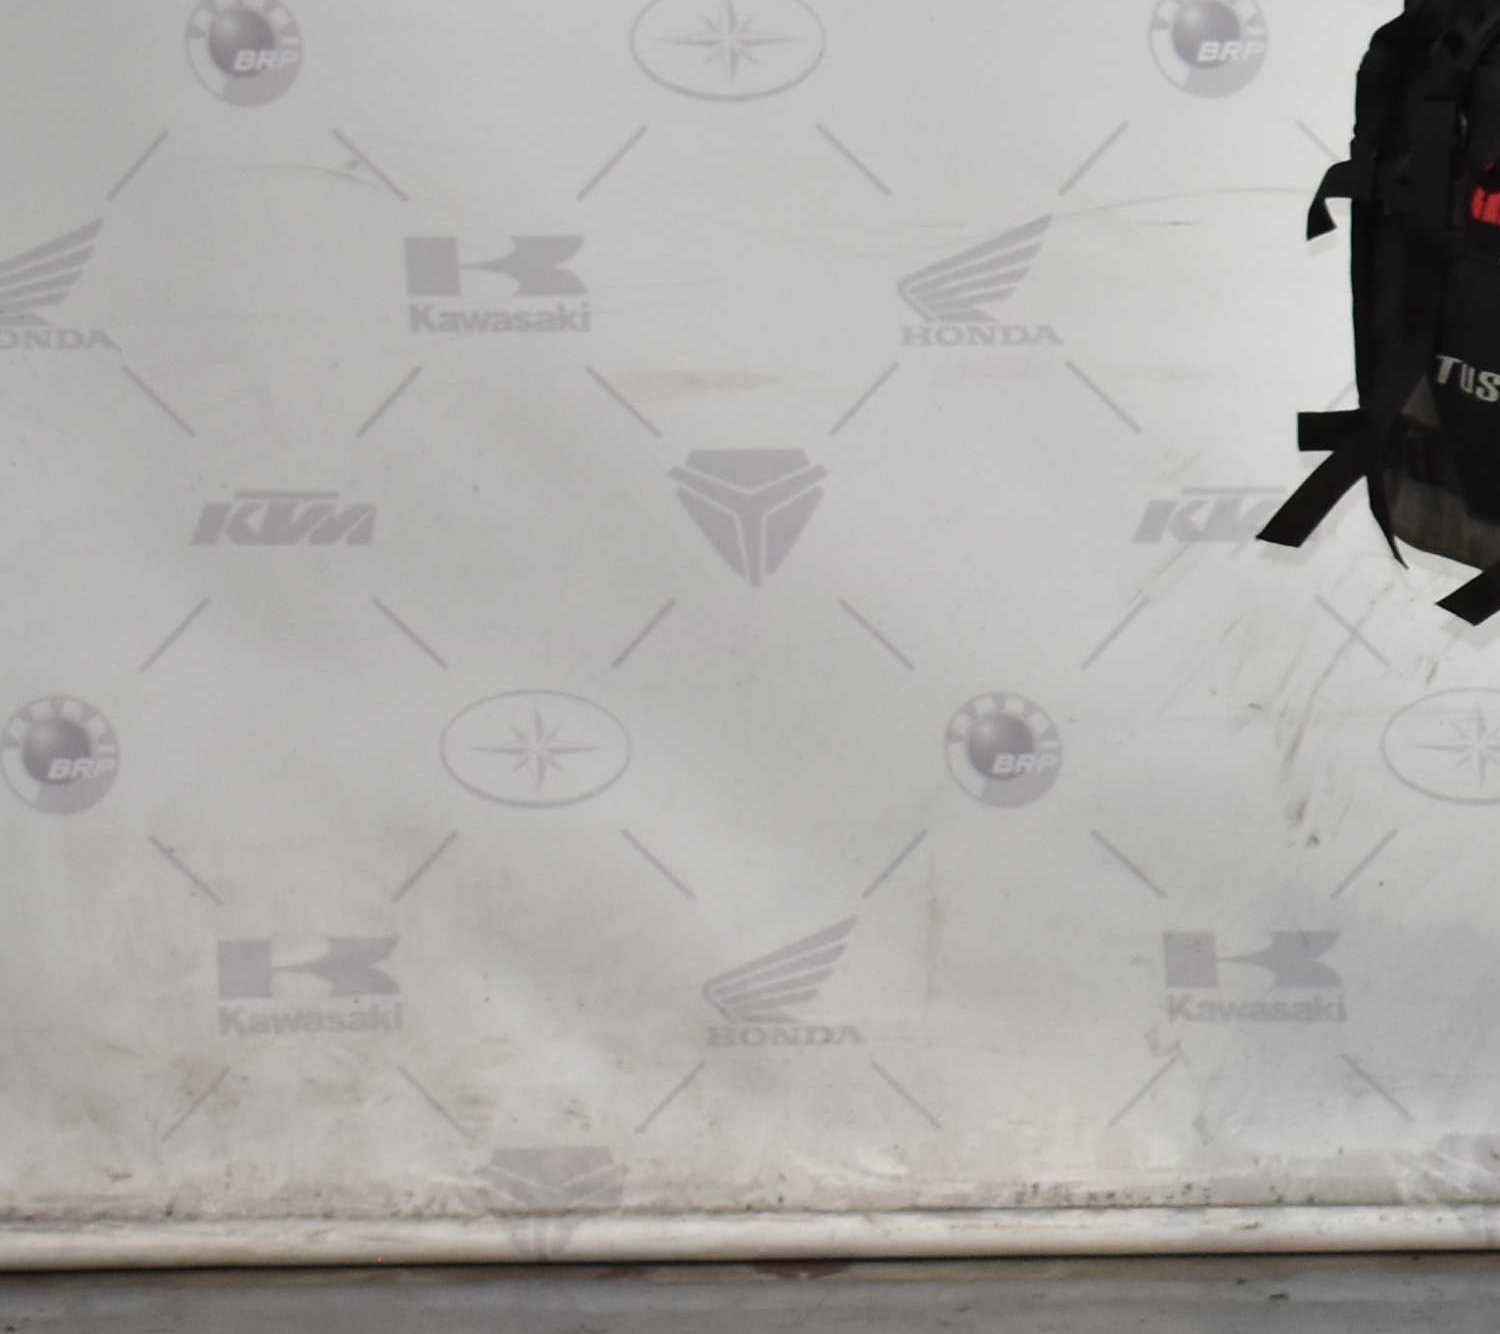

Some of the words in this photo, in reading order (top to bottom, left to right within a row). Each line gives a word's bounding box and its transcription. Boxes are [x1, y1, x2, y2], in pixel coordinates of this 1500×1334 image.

[233, 49, 299, 71] BRP
[1197, 41, 1264, 63] BRP
[408, 304, 589, 333] Kawasaki
[901, 324, 1061, 347] HONDA
[191, 491, 375, 546] KTM
[48, 757, 115, 779] BRP
[992, 752, 1058, 774] BRP
[1169, 992, 1347, 1023] Kawasaki
[218, 1003, 403, 1035] Kawasaki
[704, 1025, 863, 1047] HONDA
